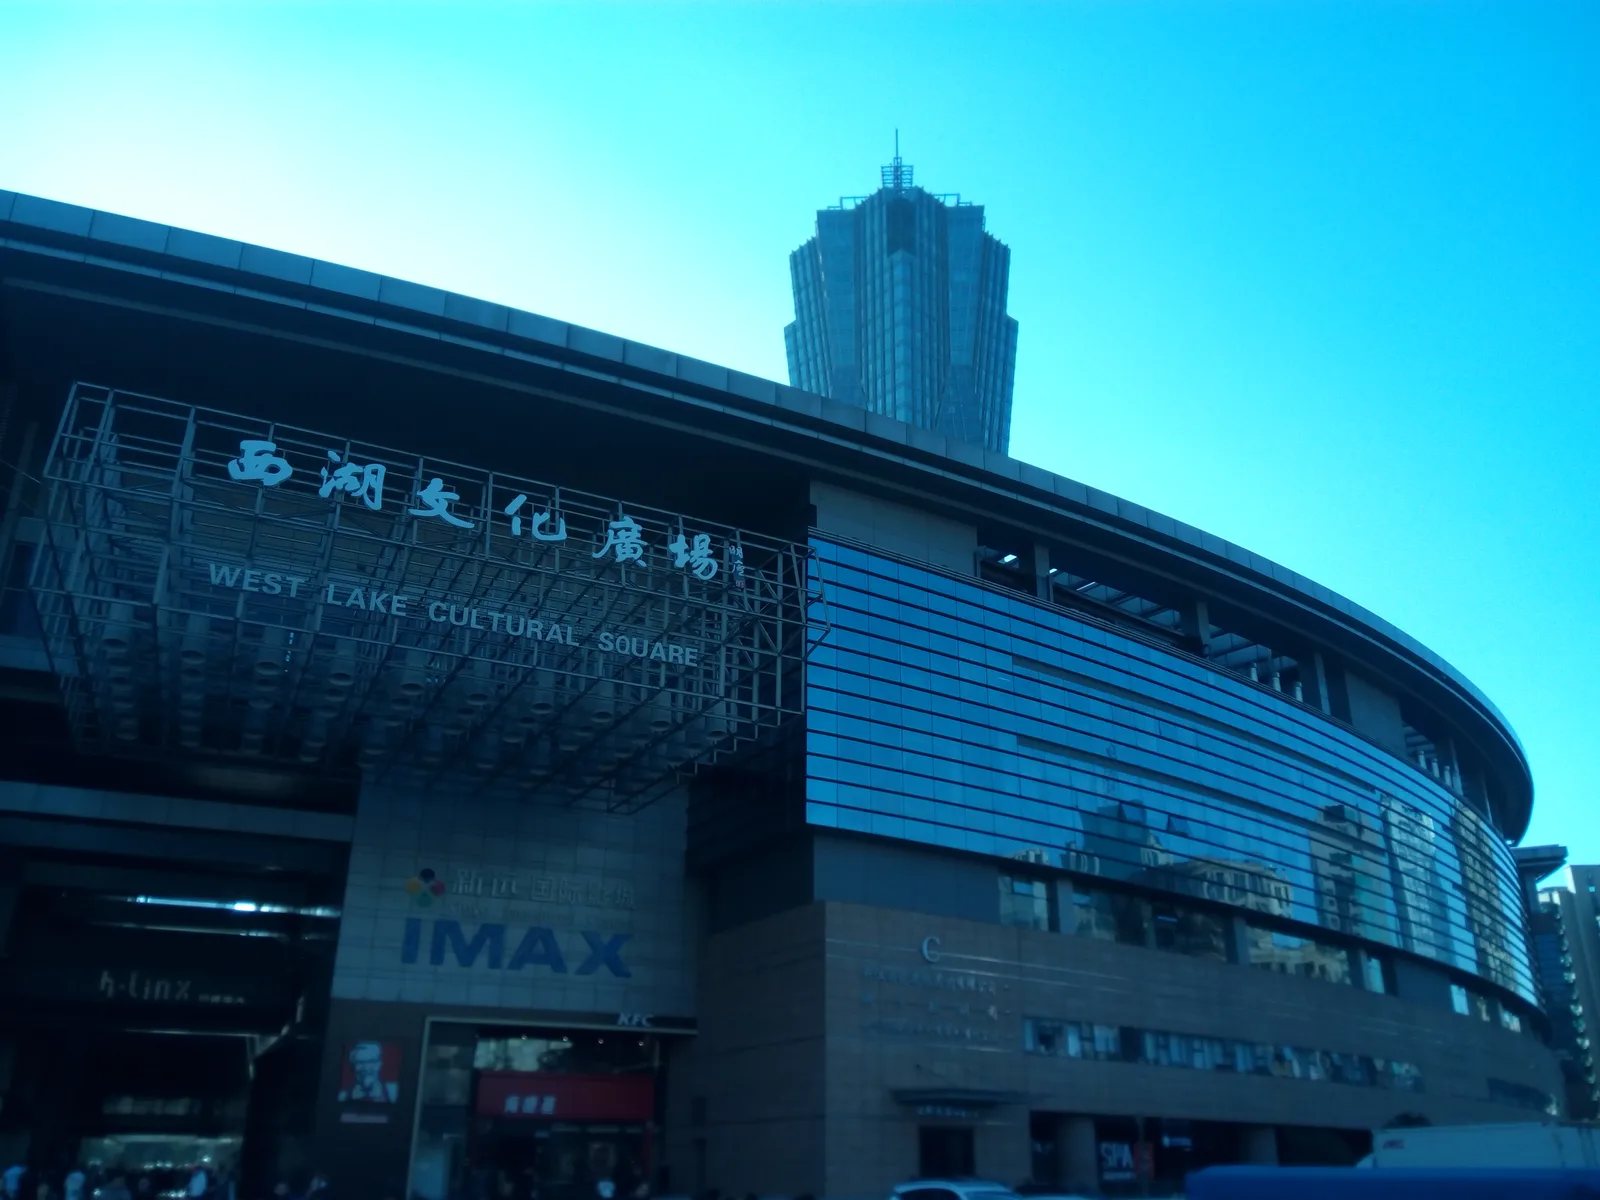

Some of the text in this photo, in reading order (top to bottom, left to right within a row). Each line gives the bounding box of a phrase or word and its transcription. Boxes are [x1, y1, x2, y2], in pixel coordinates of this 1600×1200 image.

[227, 440, 720, 582] 西湖文化廣場
[209, 563, 699, 669] WEST LAKE CULTURAL SQUARE
[401, 917, 634, 979] IMAX
[616, 1012, 654, 1027] KFC
